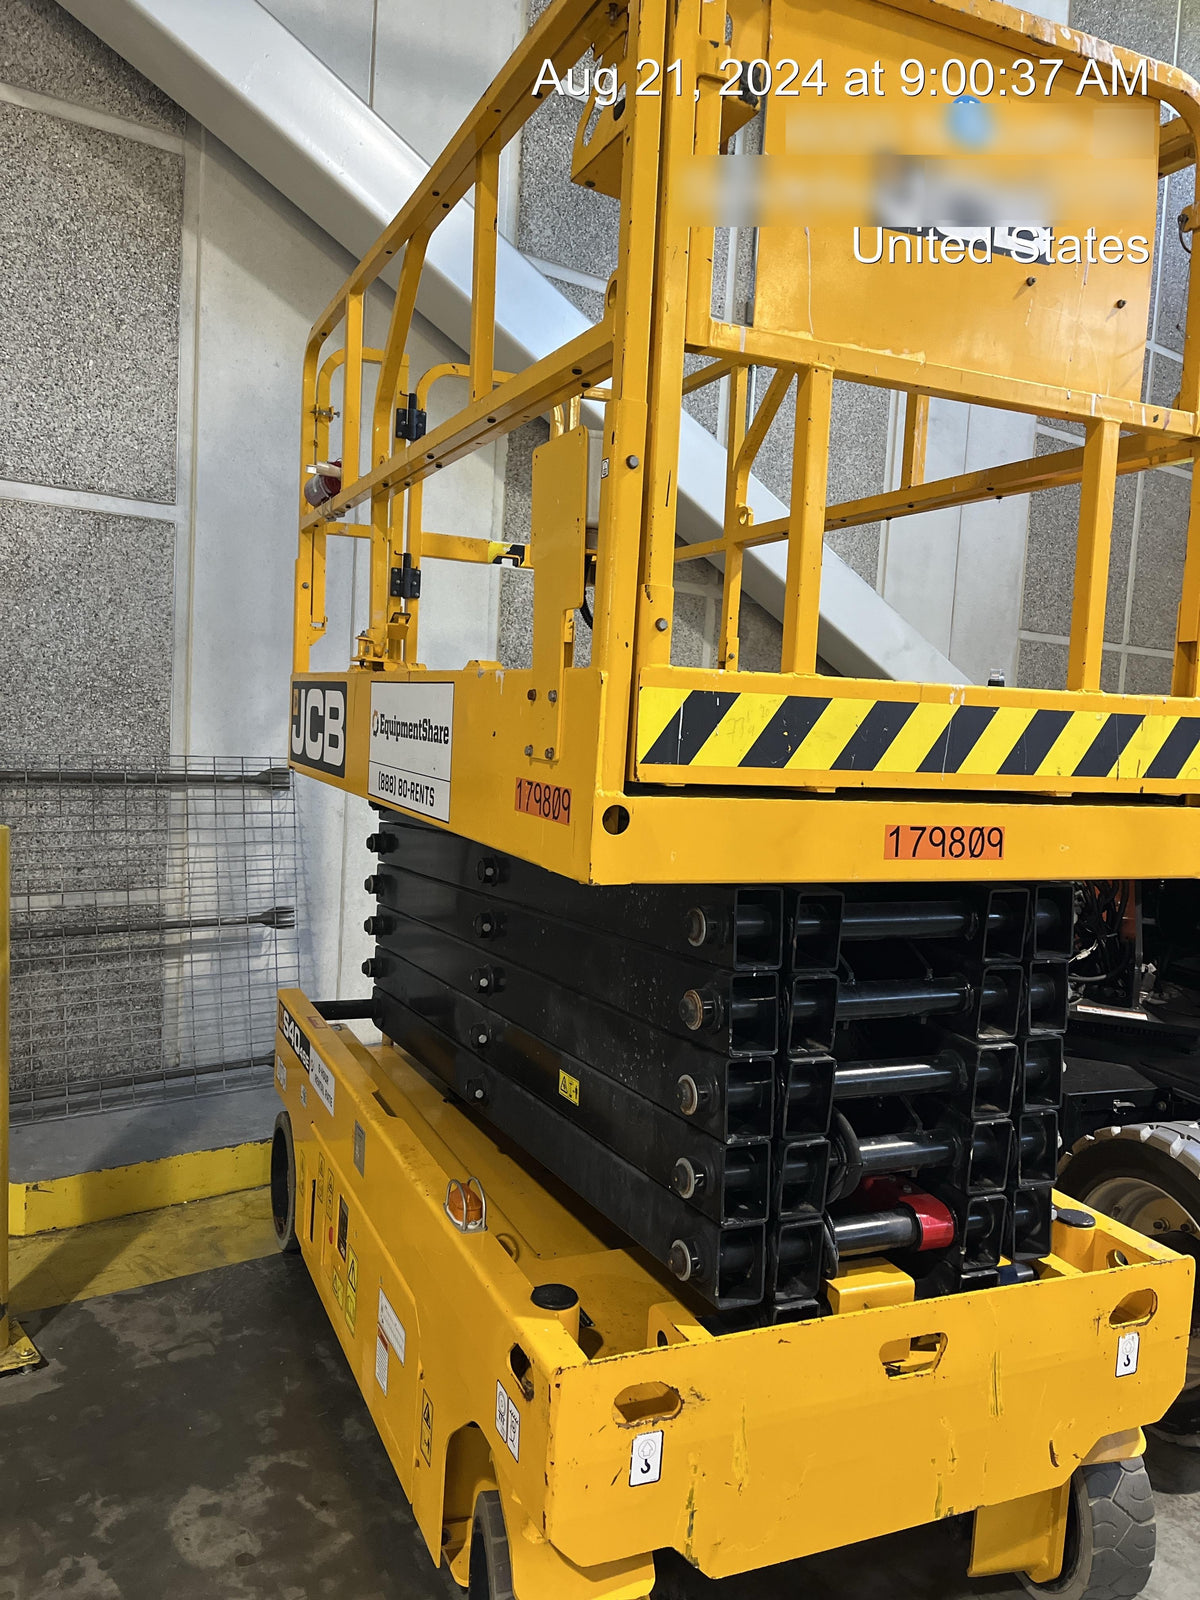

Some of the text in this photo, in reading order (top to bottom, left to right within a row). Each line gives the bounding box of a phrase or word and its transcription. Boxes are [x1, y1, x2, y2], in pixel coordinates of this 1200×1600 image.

[291, 687, 345, 767] JCB
[380, 713, 449, 745] EquipmentShare
[378, 770, 435, 807] (888) 80-RENTS
[517, 779, 571, 824] 179809
[888, 825, 1004, 859] 179809
